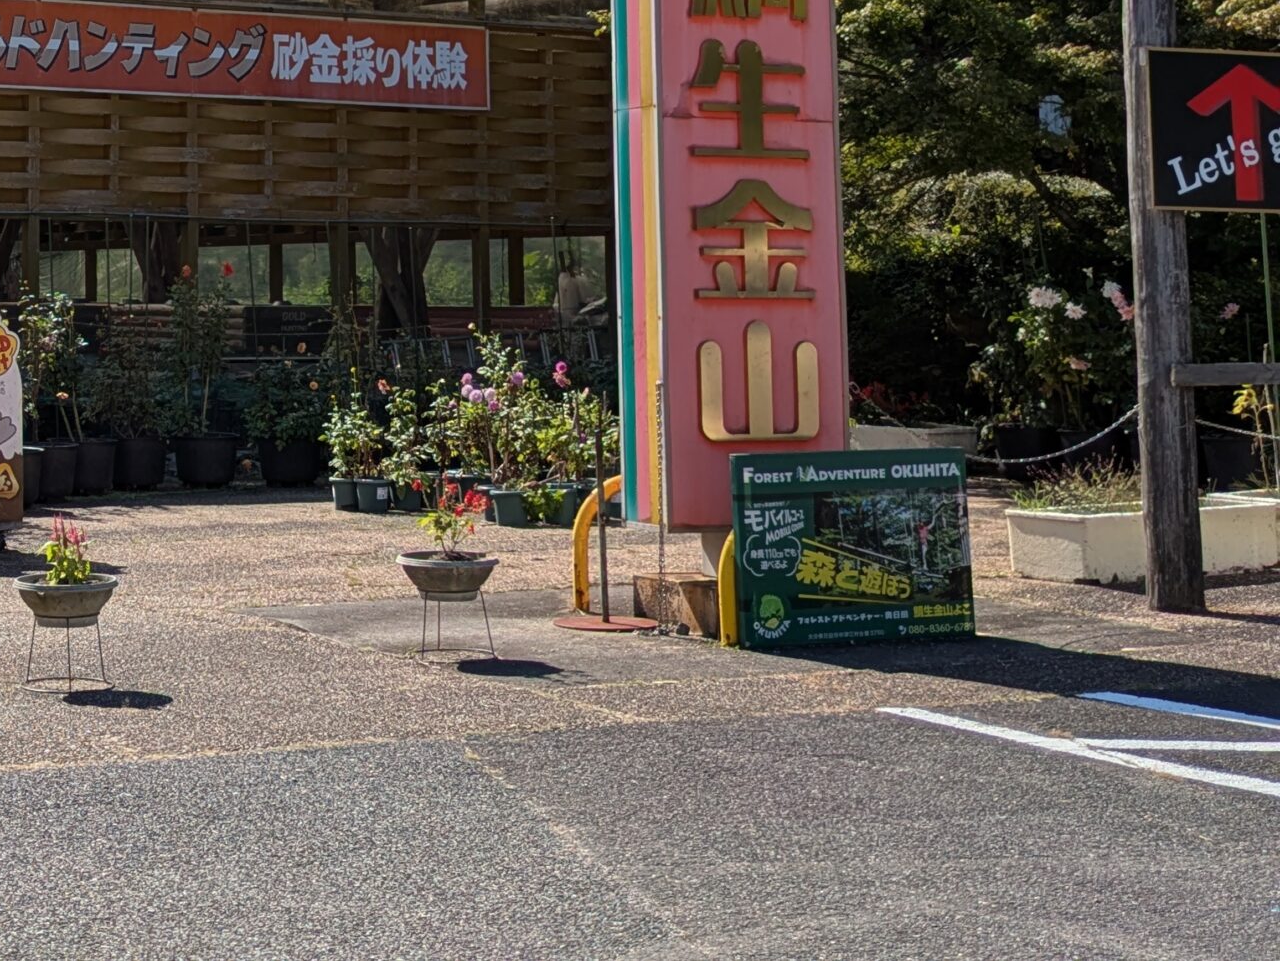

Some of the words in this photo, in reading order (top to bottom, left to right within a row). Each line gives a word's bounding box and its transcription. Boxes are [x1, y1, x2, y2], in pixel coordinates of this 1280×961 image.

[1166, 134, 1260, 196] Let's
[281, 310, 307, 322] GOLD
[890, 462, 961, 479] OKUHITA
[795, 549, 912, 599] 森と遊ぼう
